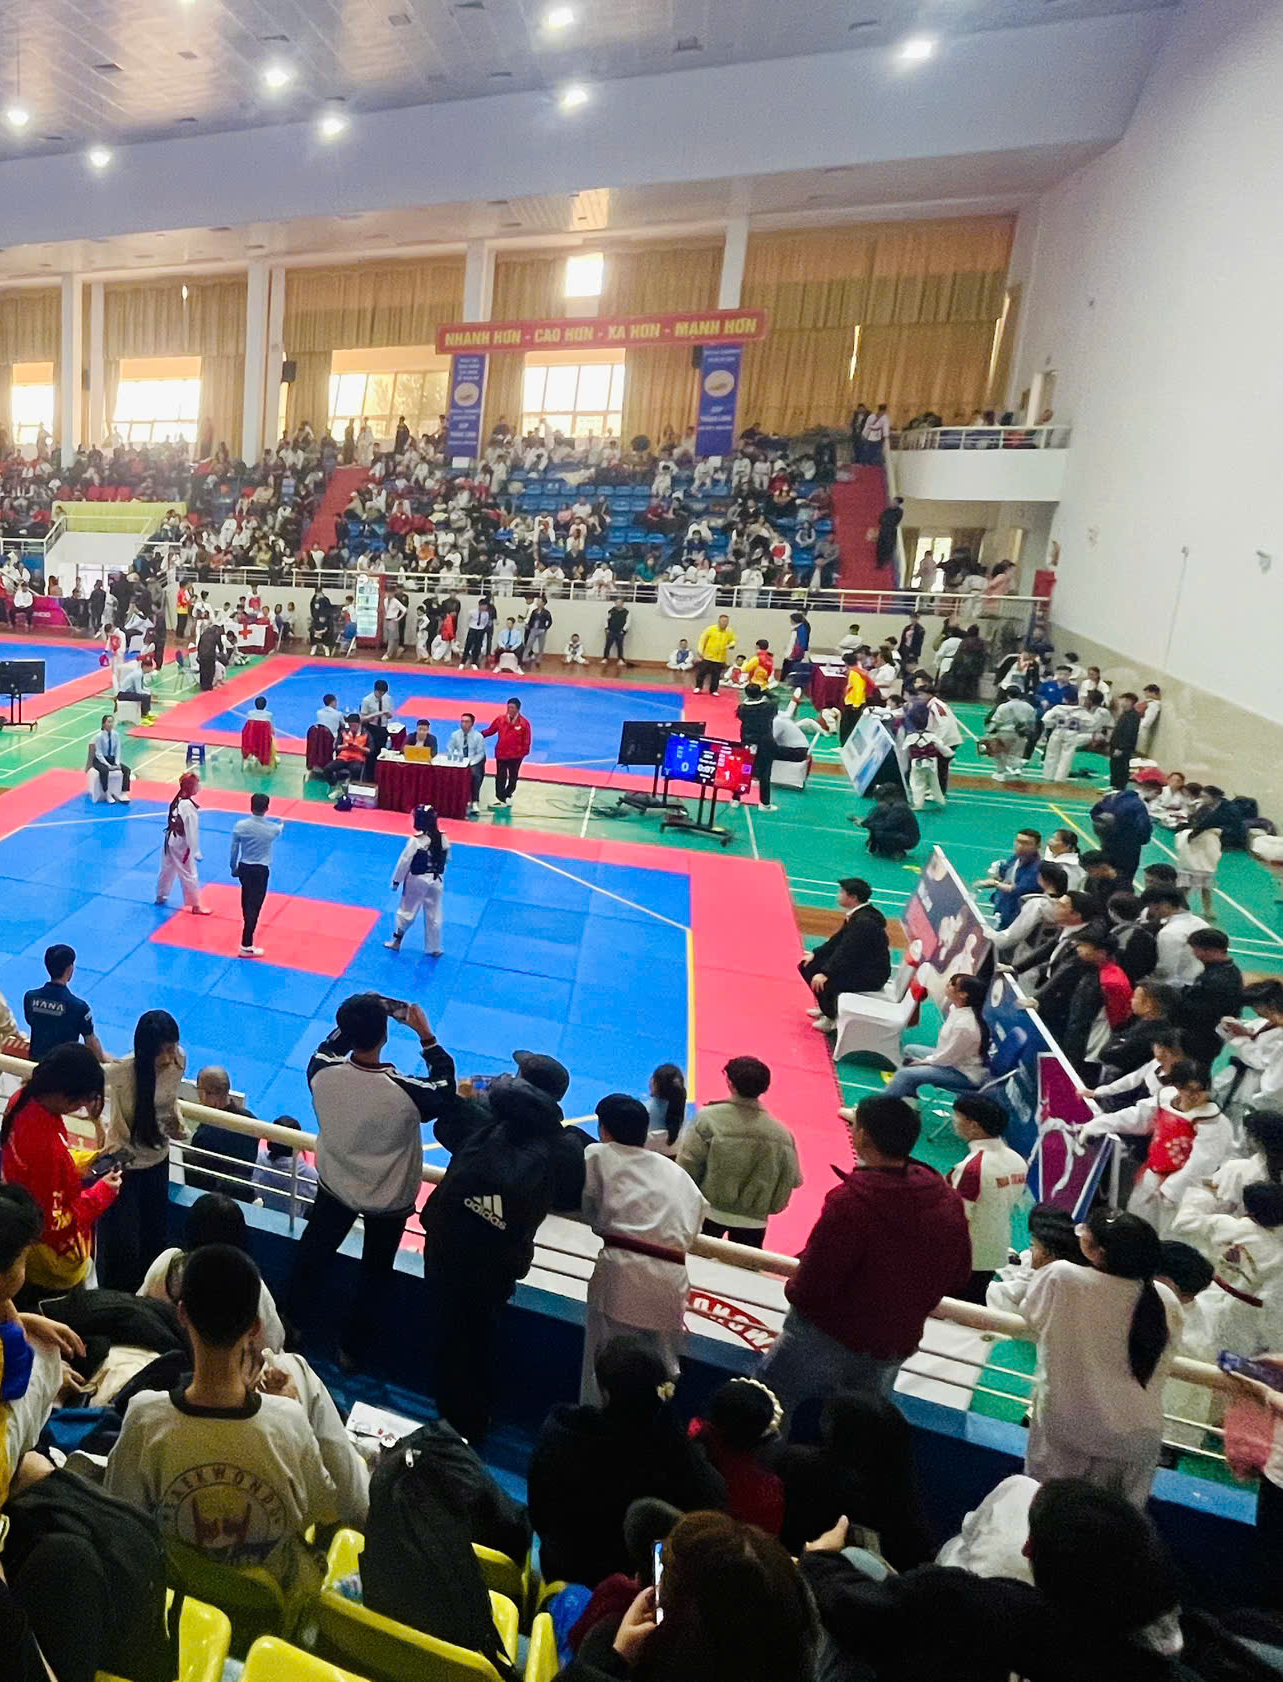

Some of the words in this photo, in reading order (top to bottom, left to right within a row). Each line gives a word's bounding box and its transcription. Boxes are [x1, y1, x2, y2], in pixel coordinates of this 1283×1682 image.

[444, 331, 490, 346] NHANH
[534, 327, 561, 343] CAO
[607, 326, 626, 340] XA
[464, 1198, 507, 1230] adidas
